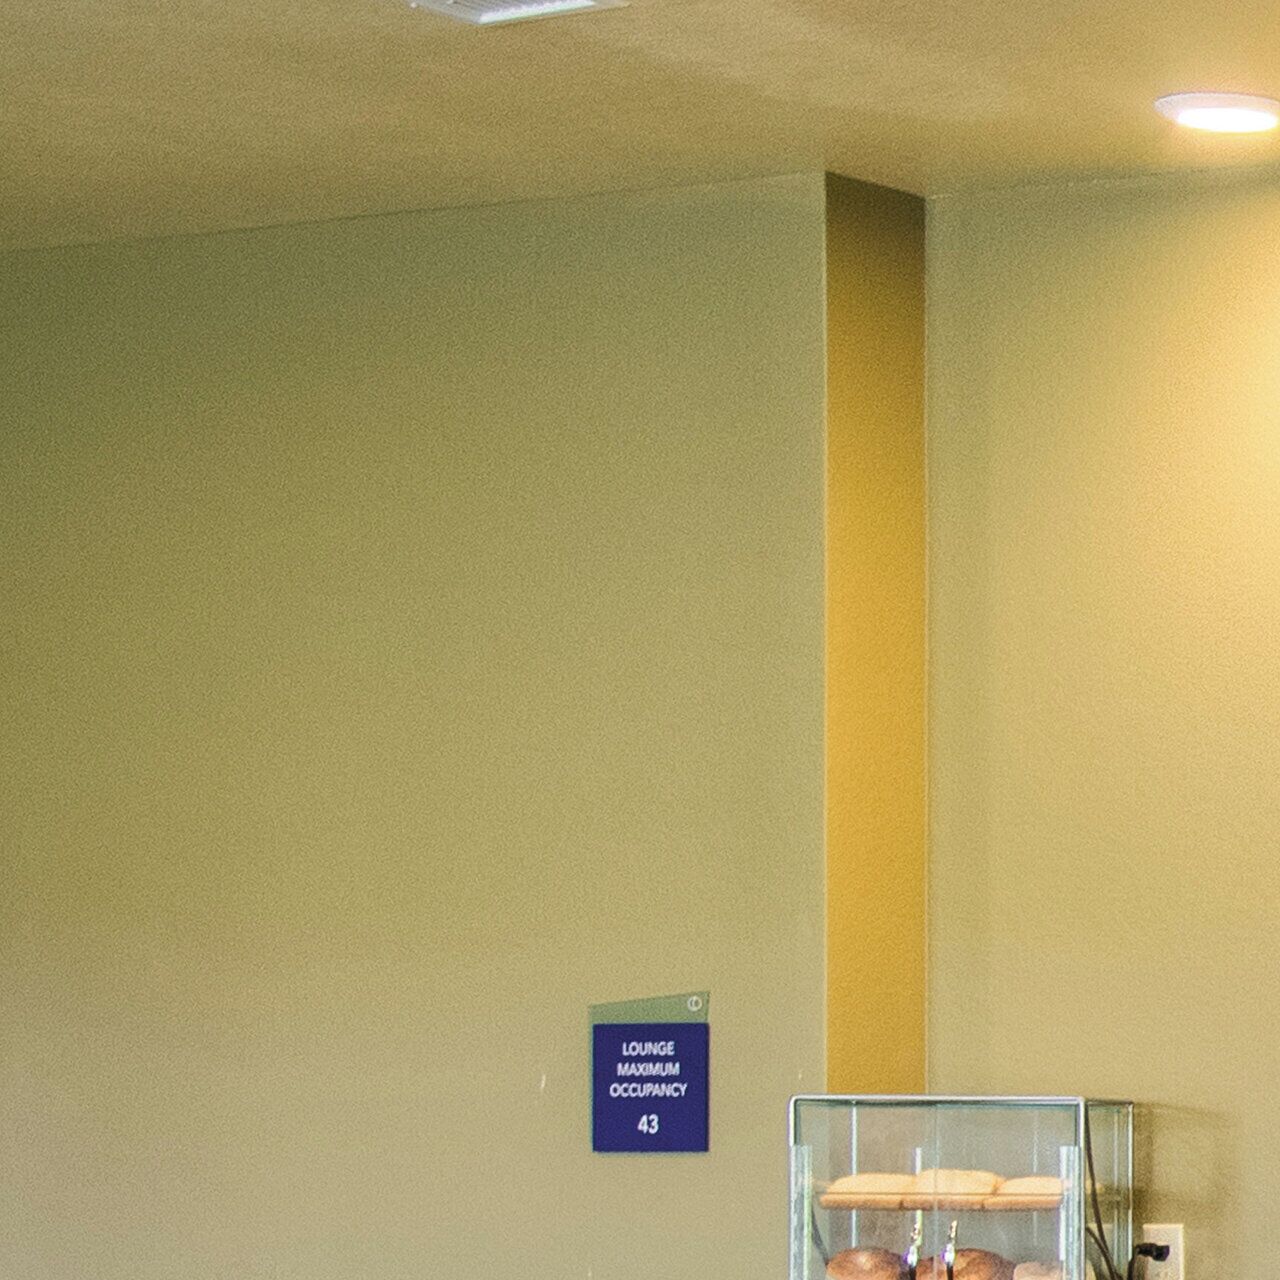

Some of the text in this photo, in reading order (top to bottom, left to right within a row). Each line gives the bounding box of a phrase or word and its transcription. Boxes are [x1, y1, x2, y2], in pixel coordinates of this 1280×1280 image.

[622, 1042, 675, 1056] LOUNGE
[617, 1062, 680, 1076] MAXIMUM
[609, 1083, 687, 1098] OCCUPANCY
[637, 1114, 659, 1134] 43
